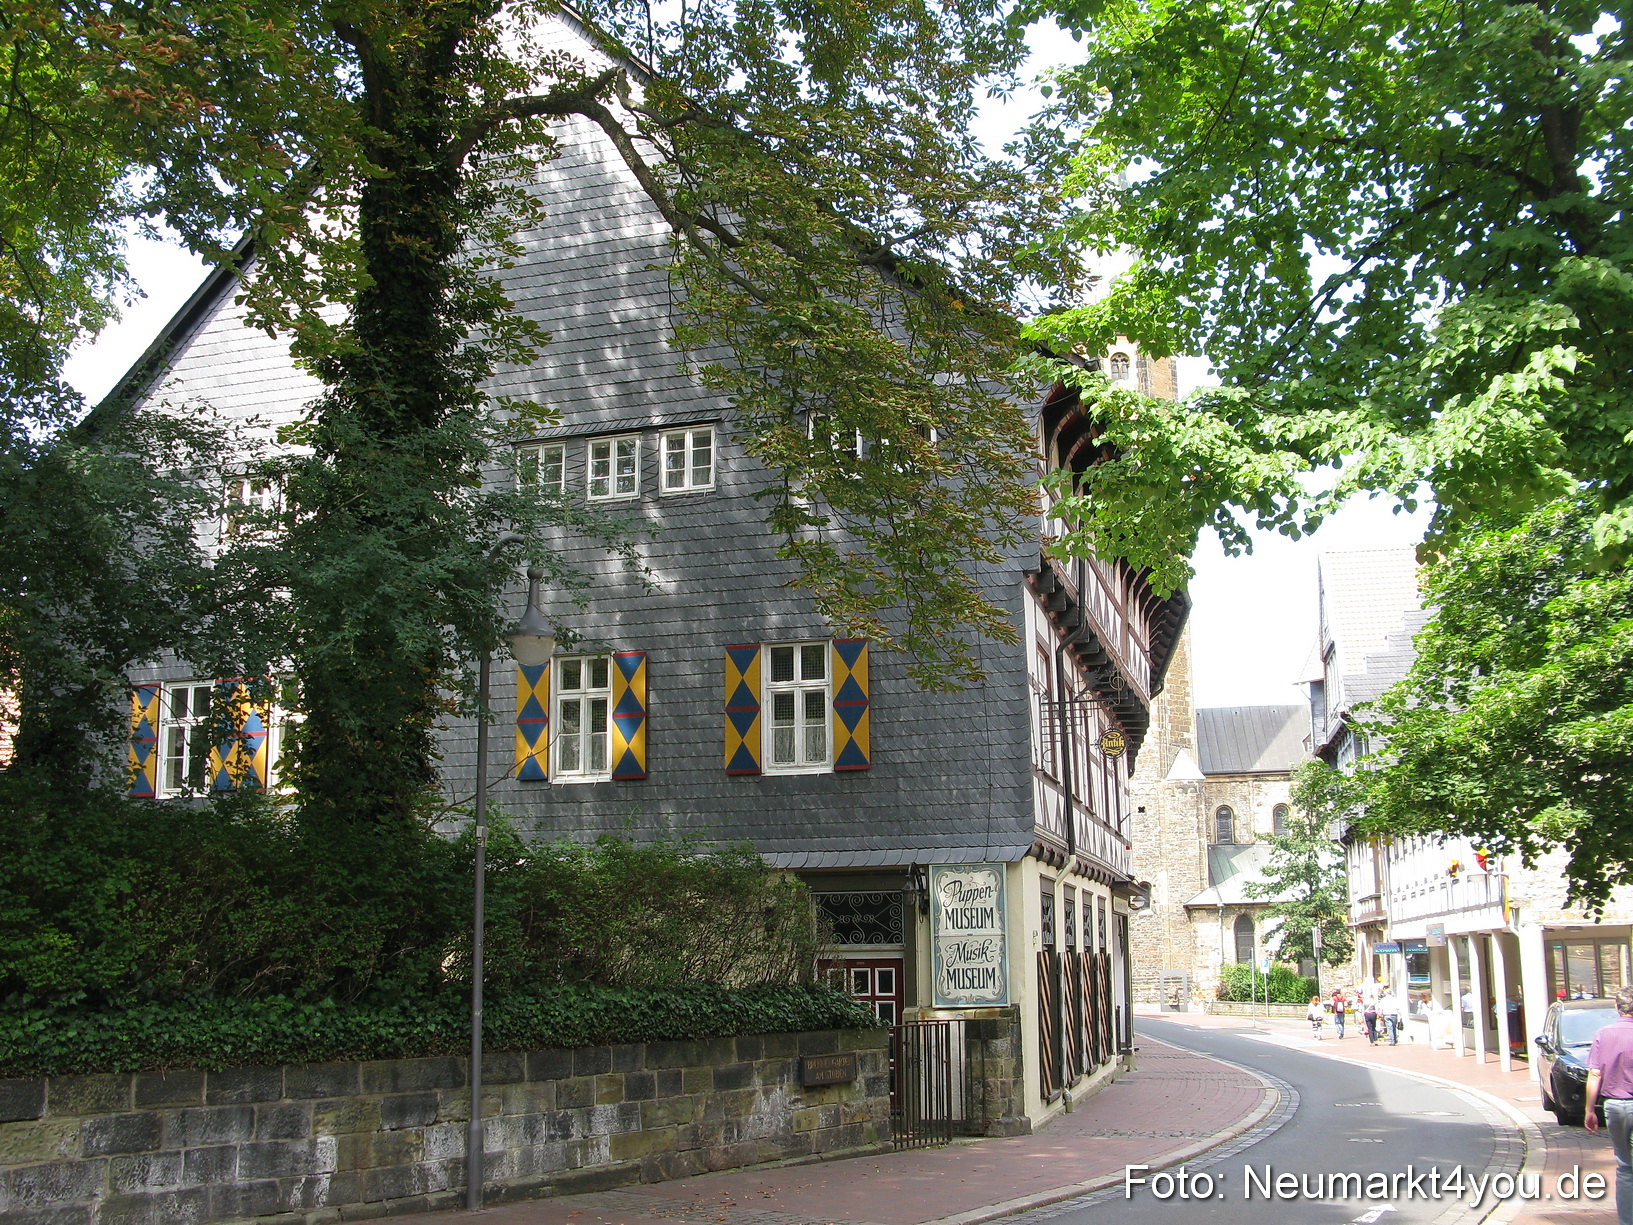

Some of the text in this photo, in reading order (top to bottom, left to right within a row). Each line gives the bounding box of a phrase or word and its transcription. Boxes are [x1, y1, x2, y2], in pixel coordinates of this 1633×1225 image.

[1101, 737, 1125, 750] Antik
[943, 880, 995, 908] Puppen-
[945, 907, 995, 930] MUSEUM
[946, 967, 996, 990] MUSEUM
